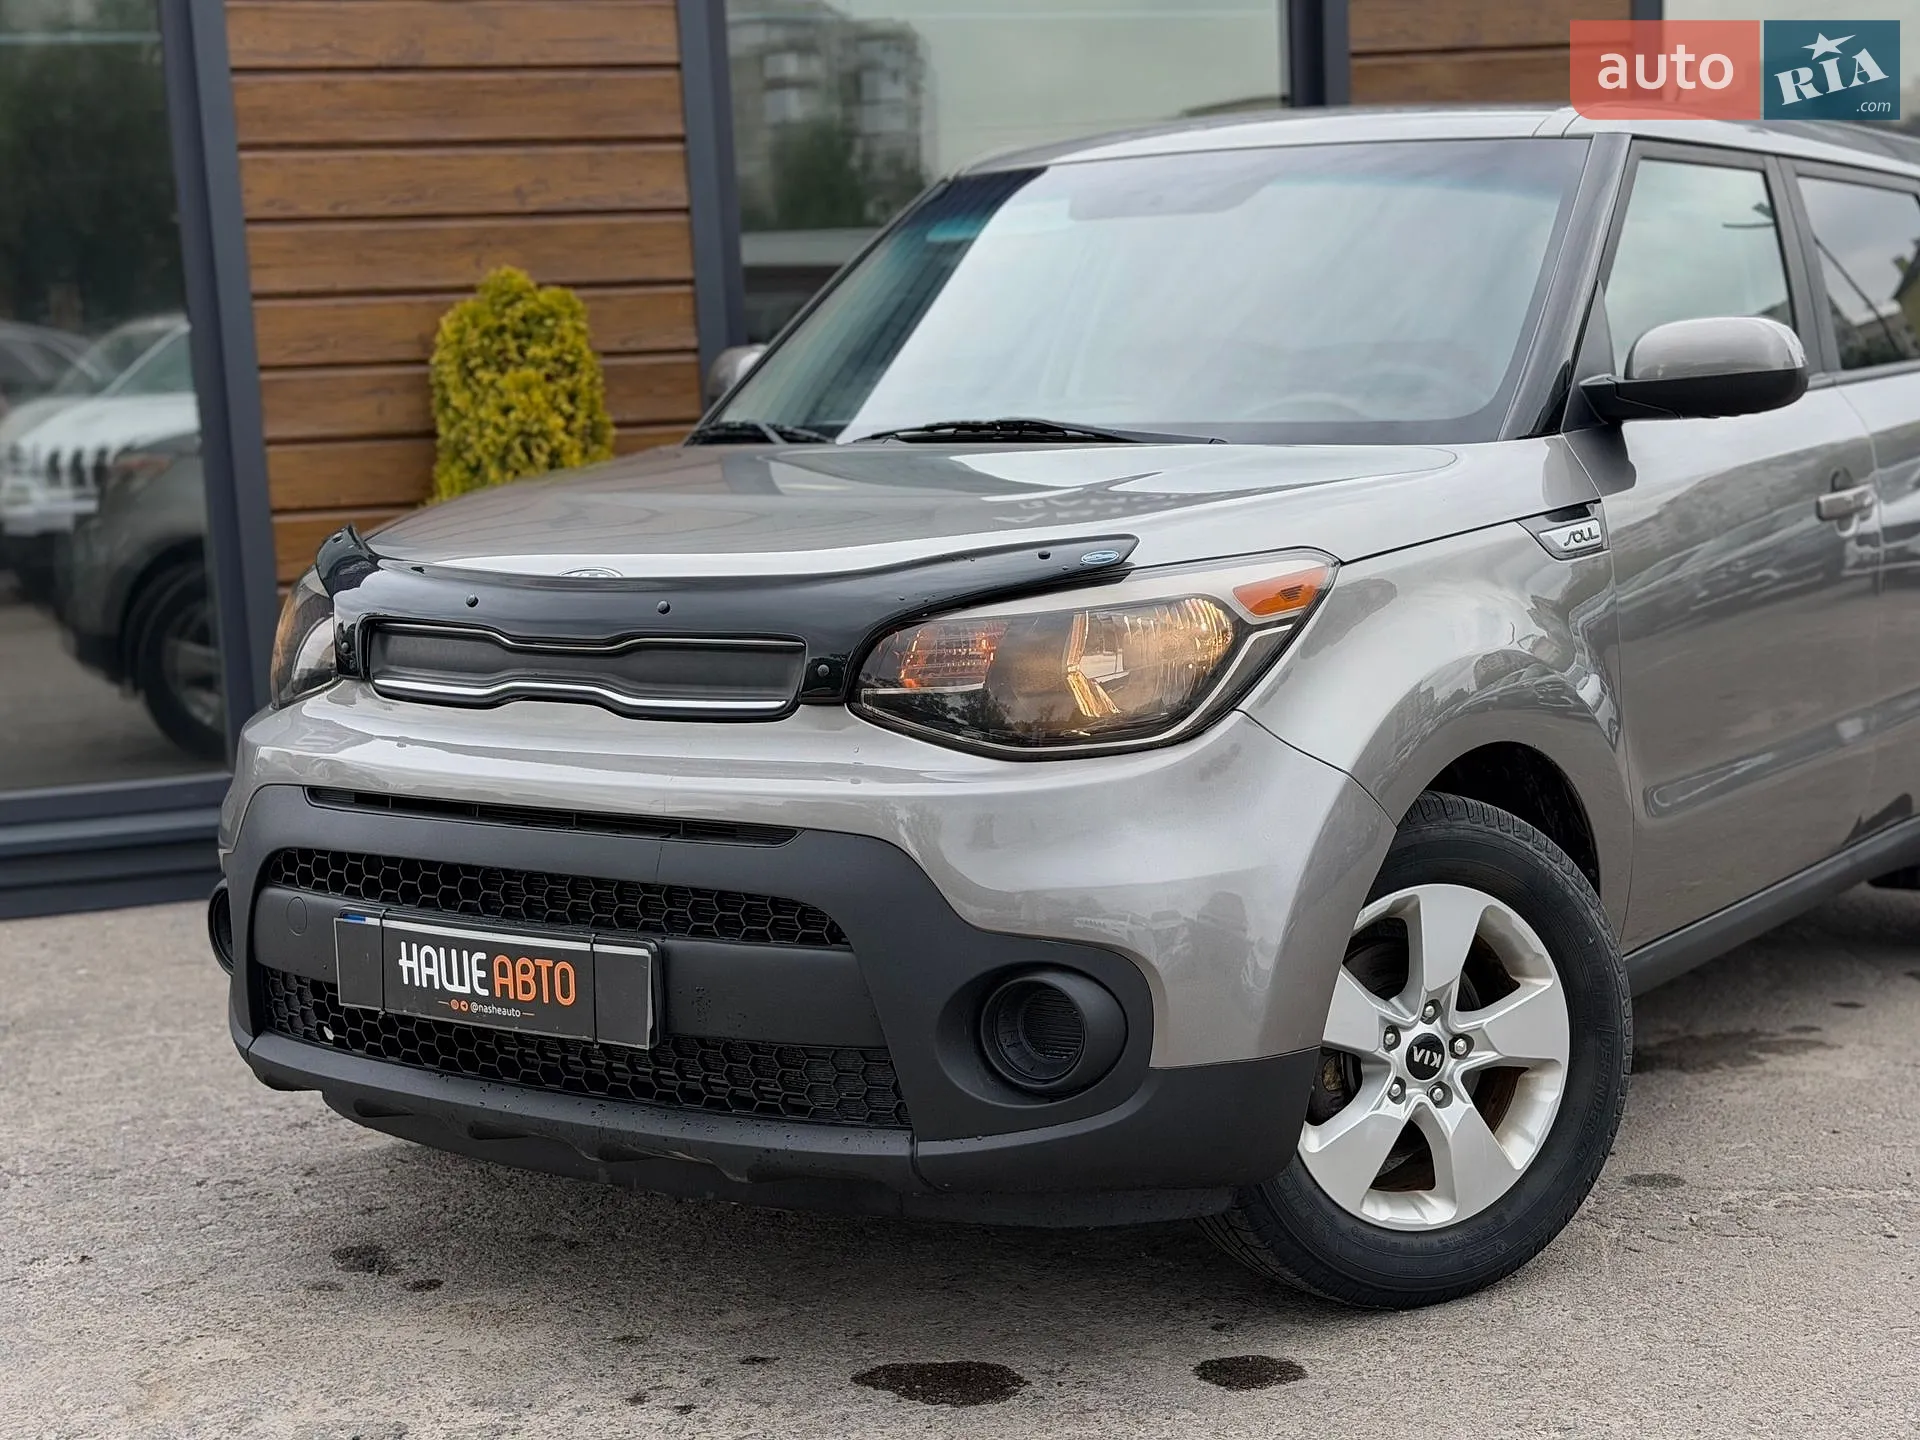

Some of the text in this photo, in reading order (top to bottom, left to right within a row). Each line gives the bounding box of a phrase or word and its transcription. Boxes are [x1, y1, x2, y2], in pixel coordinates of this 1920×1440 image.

[1563, 527, 1600, 547] SOUL
[398, 941, 577, 1006] НАШЕ АВТО
[470, 1001, 521, 1018] @nasheauto
